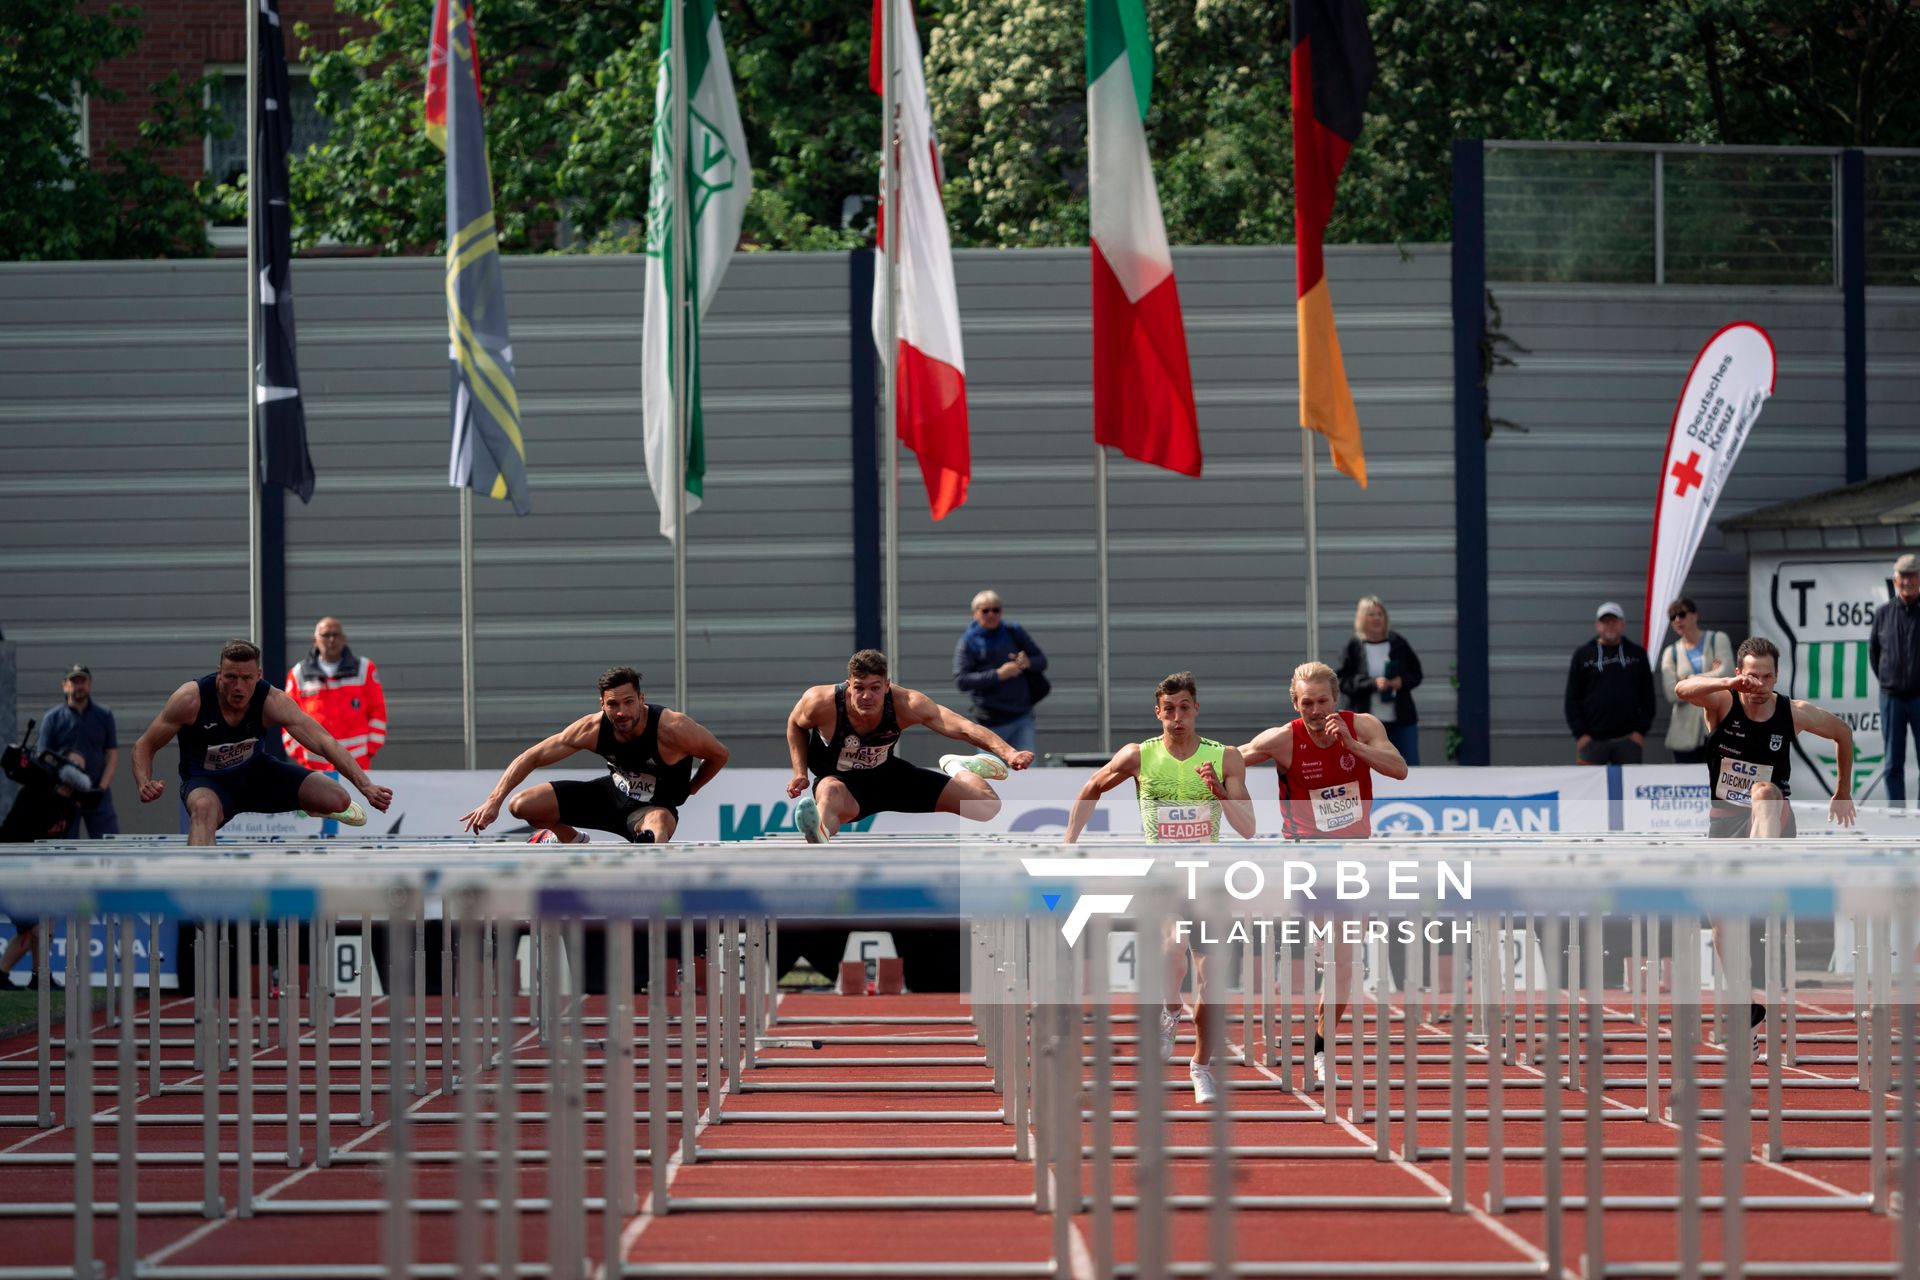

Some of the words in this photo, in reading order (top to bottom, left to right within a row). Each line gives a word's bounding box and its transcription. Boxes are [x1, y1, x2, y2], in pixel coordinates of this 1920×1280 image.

[1687, 354, 1733, 438] Deutsches
[1698, 397, 1725, 444] Rotes
[1708, 403, 1736, 451] Kreuz
[1790, 580, 1816, 627] T
[1825, 602, 1875, 626] 1865
[1731, 762, 1758, 776] GLS
[1321, 786, 1346, 800] GLS
[1721, 772, 1760, 791] DIECKMA
[1169, 809, 1197, 820] GLS
[1319, 796, 1358, 816] NILSSON
[1161, 823, 1209, 838] LEADER
[1443, 807, 1550, 832] PLAN
[337, 943, 357, 983] 8
[1117, 940, 1136, 980] 4
